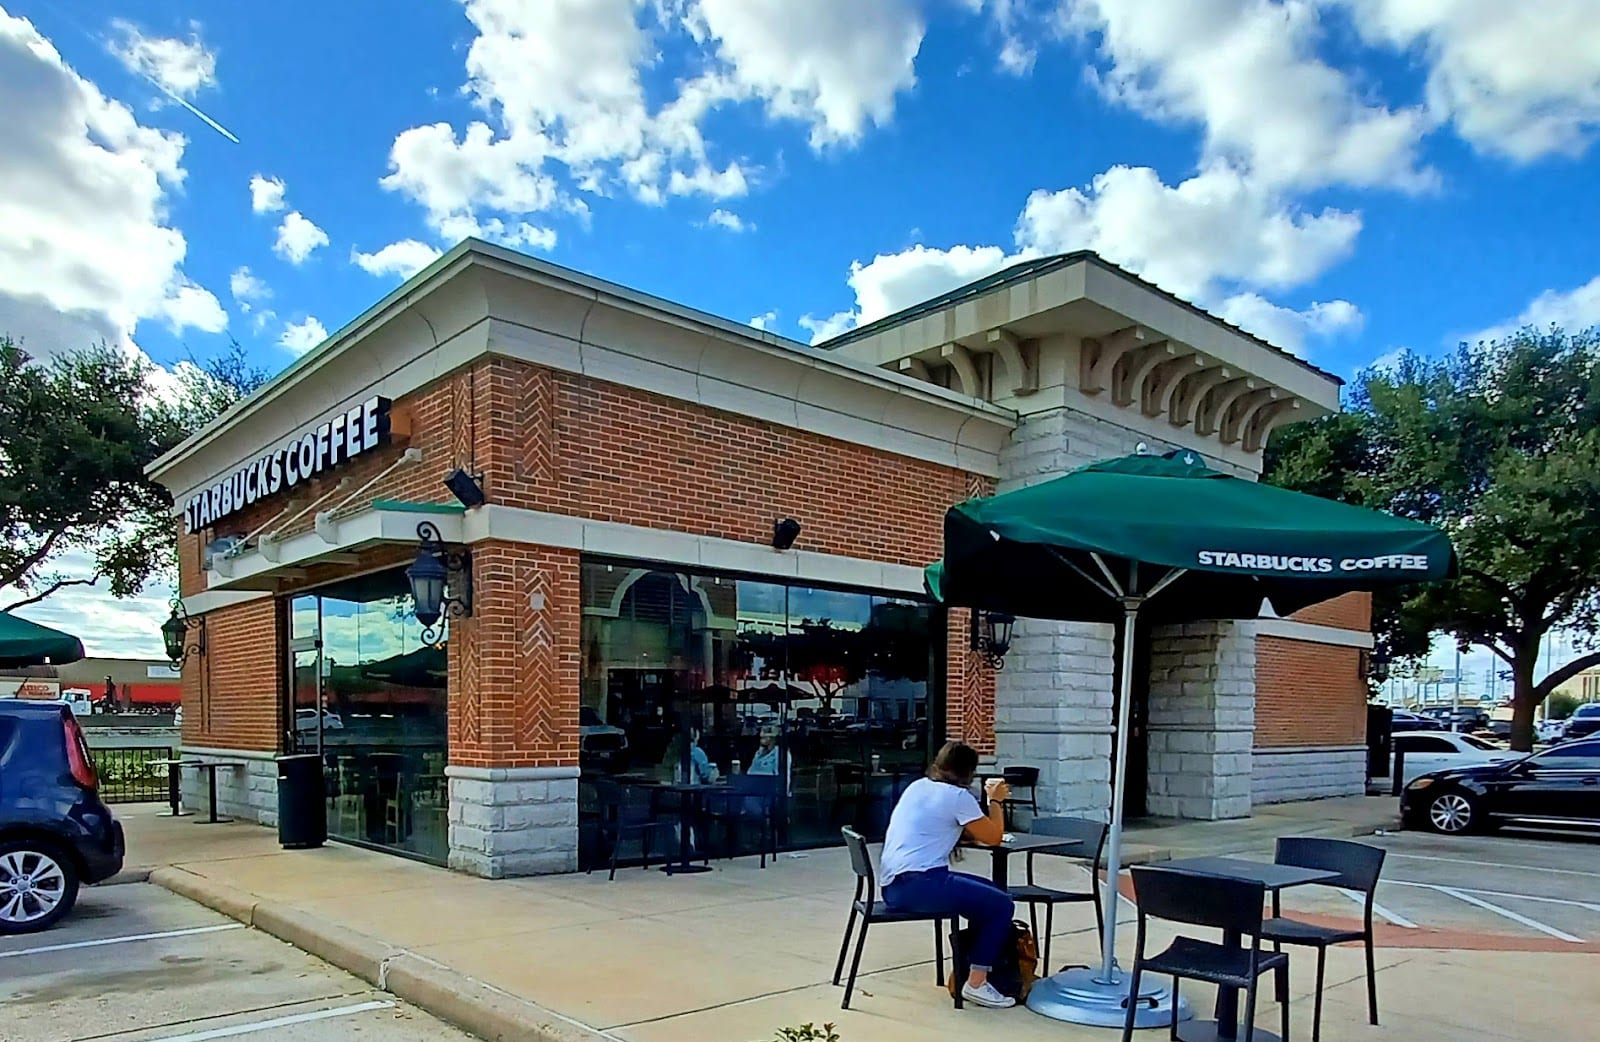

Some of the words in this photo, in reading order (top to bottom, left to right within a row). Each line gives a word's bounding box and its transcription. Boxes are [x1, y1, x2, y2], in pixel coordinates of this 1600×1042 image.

[184, 449, 283, 535] STARBUCKS
[285, 396, 381, 487] COFFEE
[1198, 551, 1333, 573] STARBUCKS
[1340, 554, 1429, 571] COFFEE
